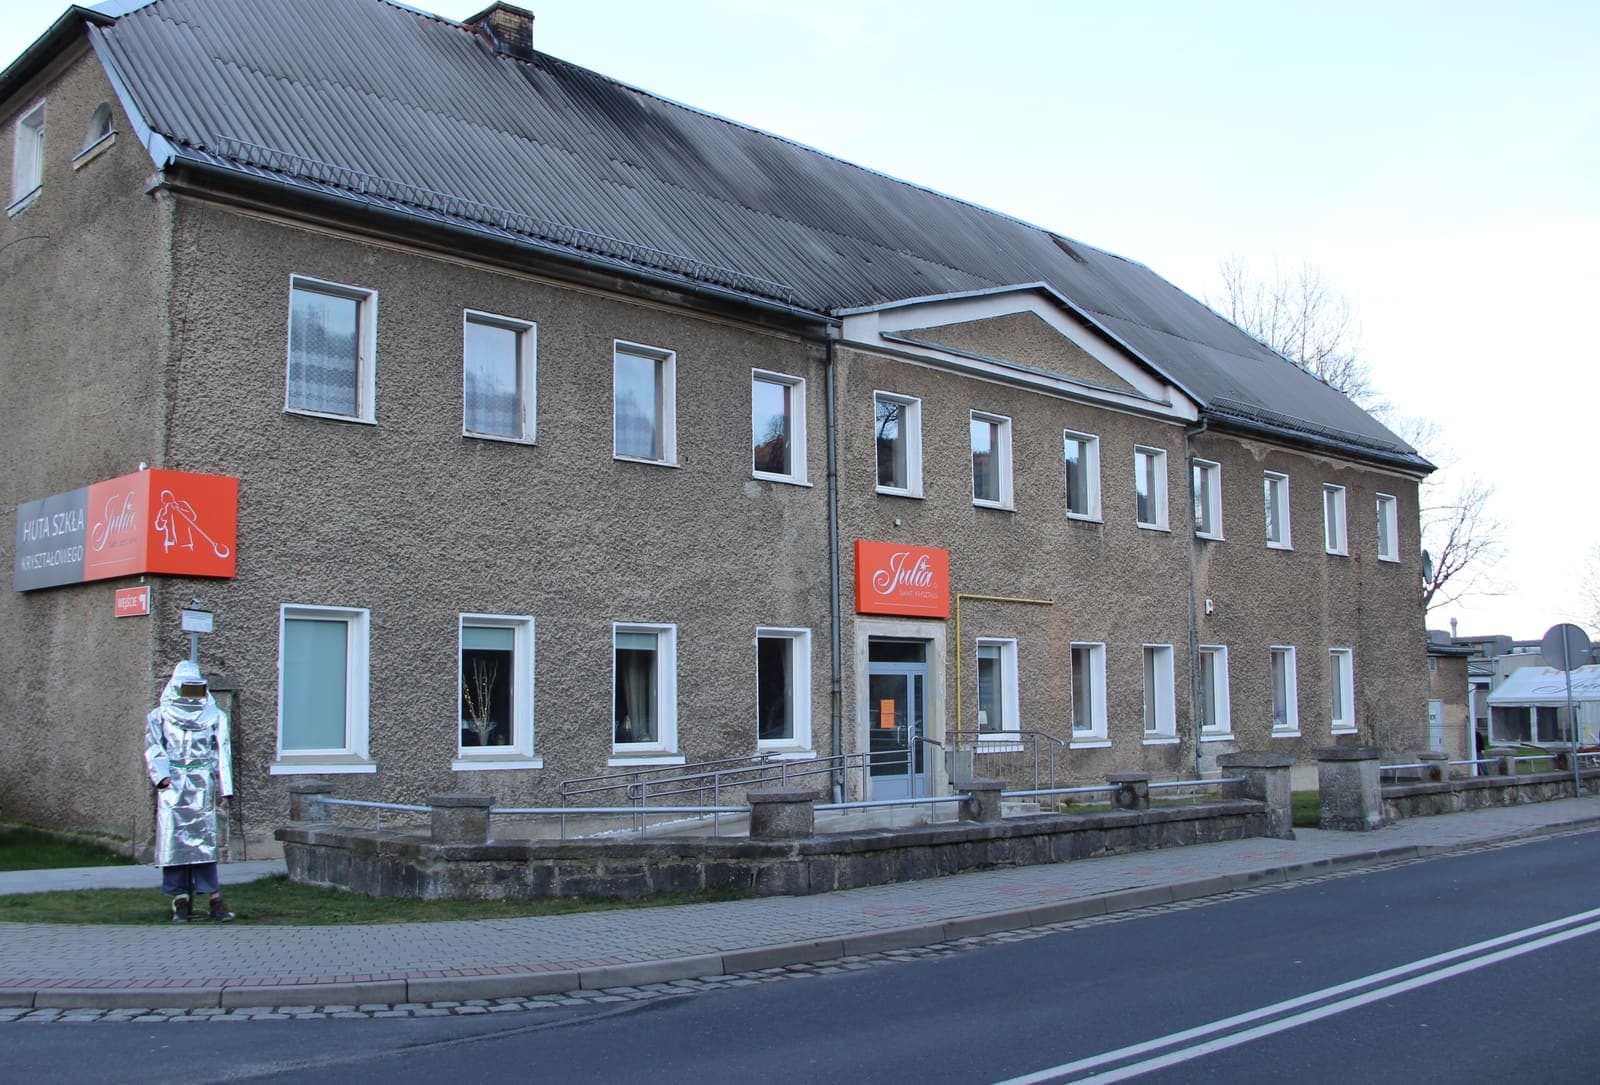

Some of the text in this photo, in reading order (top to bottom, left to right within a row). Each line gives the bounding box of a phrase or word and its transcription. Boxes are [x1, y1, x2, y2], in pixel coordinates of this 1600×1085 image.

[23, 508, 85, 542] HUTA SZKŁA
[21, 545, 84, 571] KRYSZTAŁOWEGO
[872, 551, 934, 595] Julia
